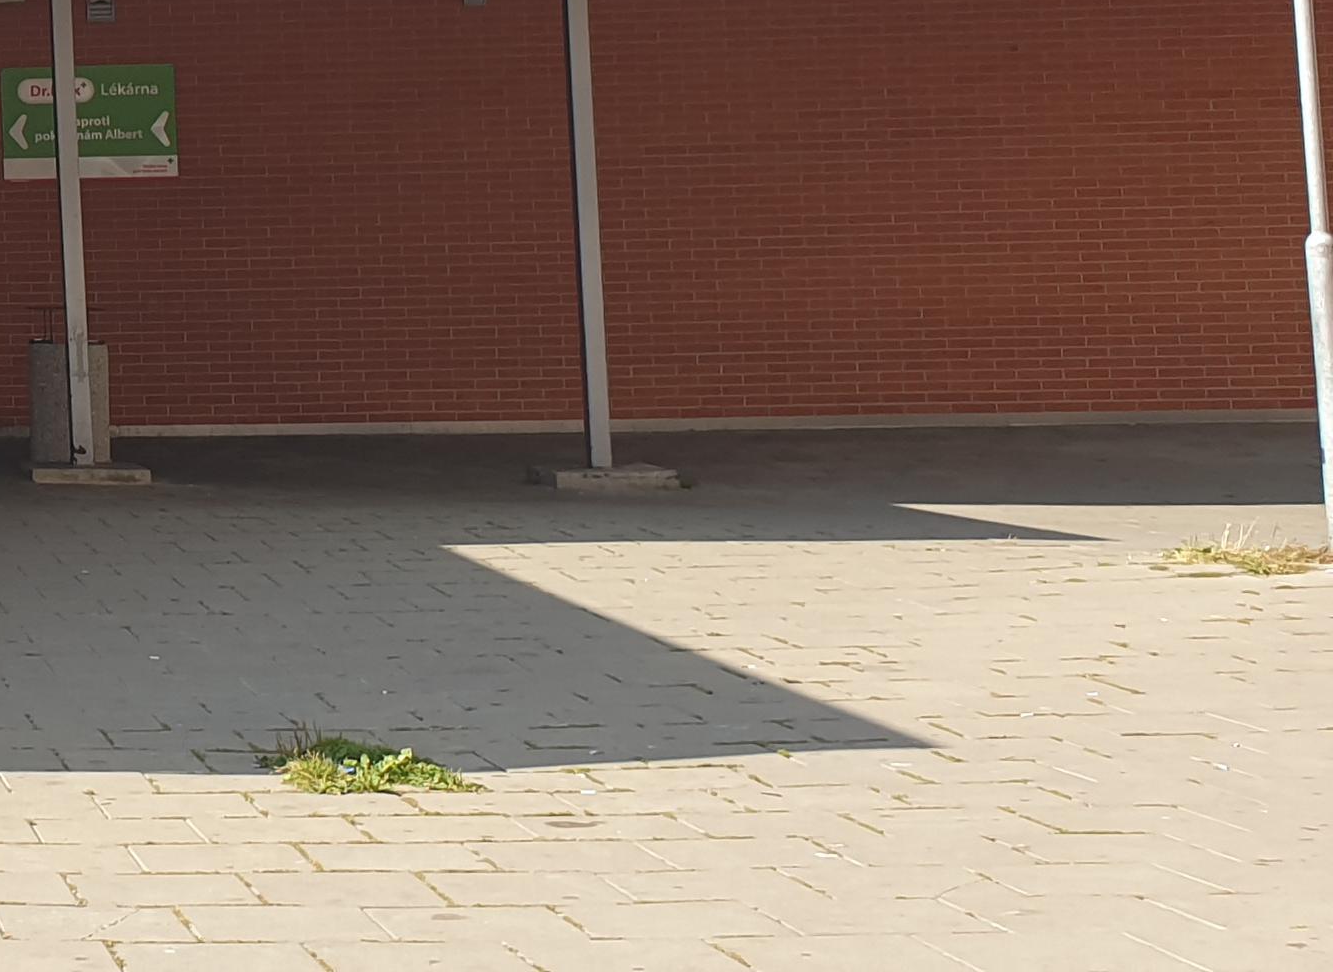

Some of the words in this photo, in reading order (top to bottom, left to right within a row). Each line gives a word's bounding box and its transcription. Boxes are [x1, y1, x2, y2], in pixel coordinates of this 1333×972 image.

[30, 84, 81, 98] Dr.x
[101, 81, 159, 96] Lékárna
[105, 128, 144, 141] Albert
